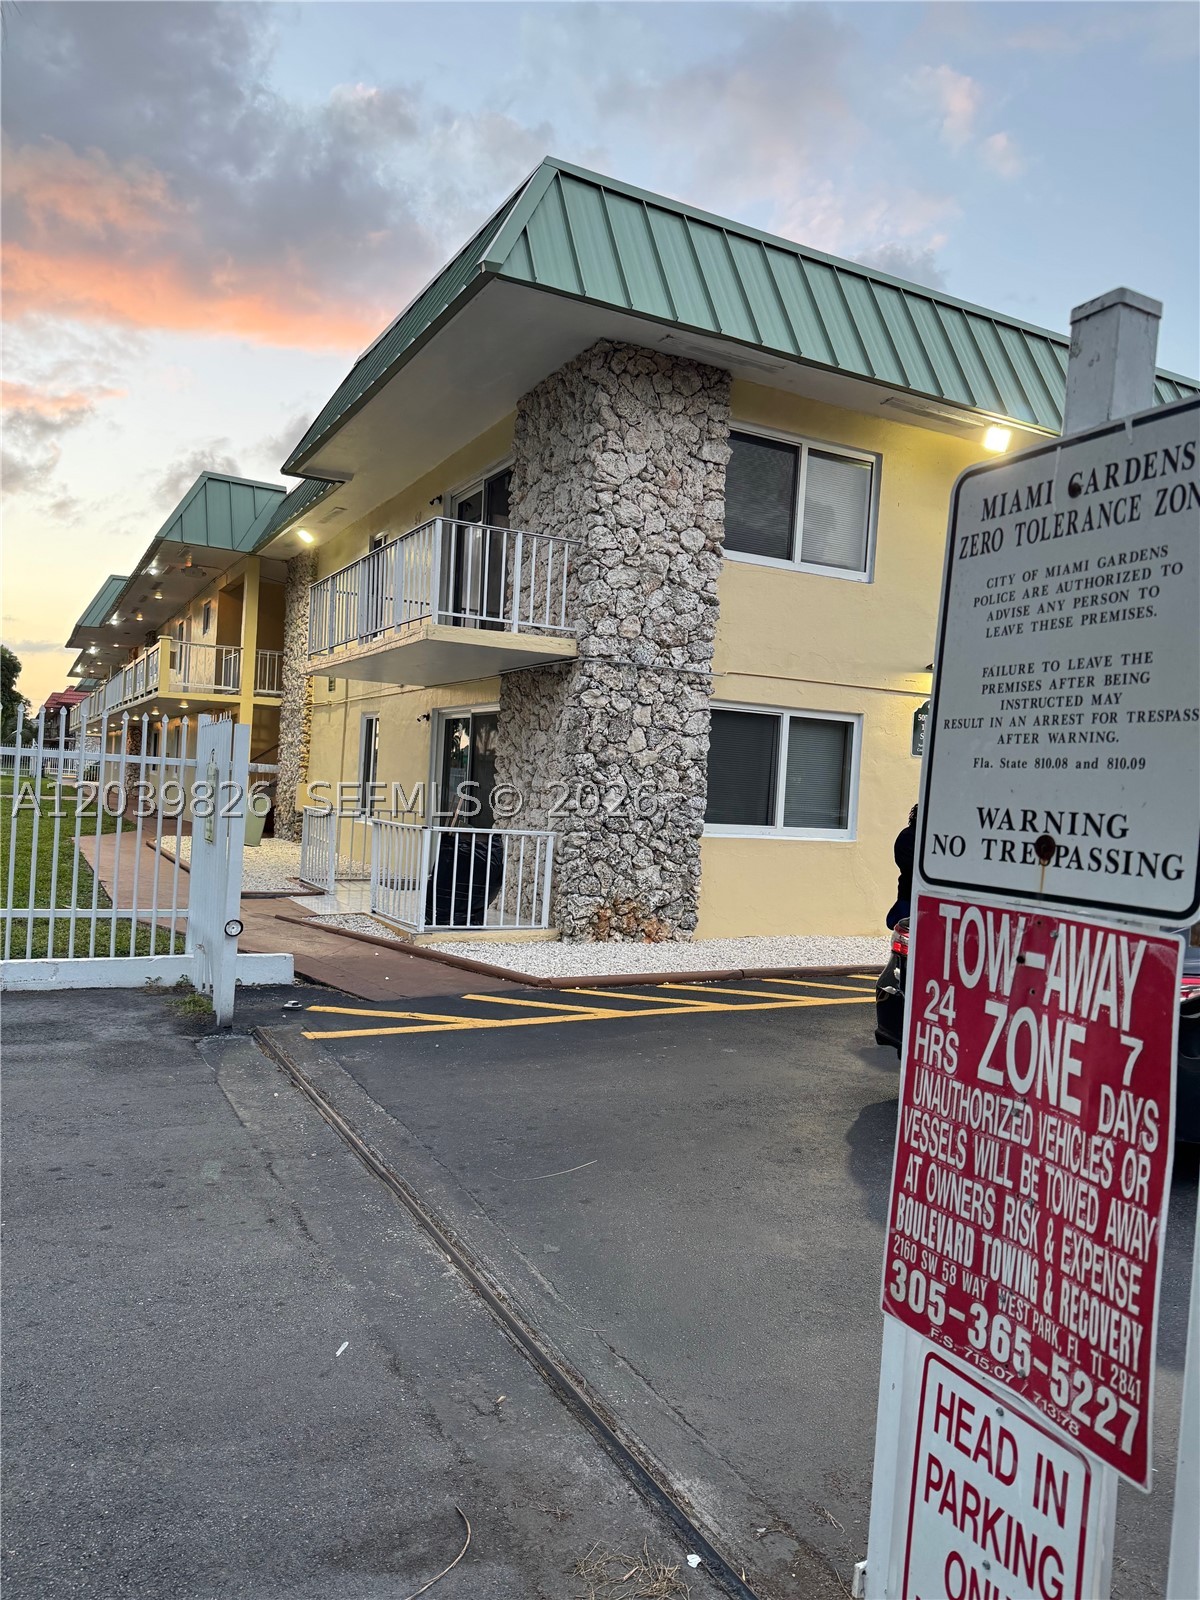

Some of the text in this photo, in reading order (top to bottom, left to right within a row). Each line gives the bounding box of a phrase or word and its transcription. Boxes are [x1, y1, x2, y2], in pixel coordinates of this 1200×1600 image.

[981, 441, 1196, 522] MIAMI GARDENS
[959, 528, 1004, 560] ZERO
[1015, 494, 1142, 548] TOLERANCE
[986, 545, 1169, 589] CITY OF MIAMI GARDENS
[973, 562, 1184, 608] POLICE ARE AUTHORIZED TO
[985, 605, 1158, 639] LEAVE THESE PREMISES.
[986, 585, 1160, 622] ADVISE ANY PERSON TO
[981, 671, 1151, 695] PREMISES AFTER BEING
[982, 651, 1153, 678] FAILURE TO LEAVE THE
[1000, 692, 1122, 711] INSTRUCTED MAY
[943, 708, 1200, 730] RESULT IN AN ARREST FOR TRESPASS
[997, 731, 1119, 745] AFTER WARNING.
[973, 757, 1146, 770] Fla. State 810.08 and 810.09
[931, 833, 967, 858] NO
[976, 806, 1130, 840] WARNING
[939, 903, 1147, 1032] TOW-AWAY
[914, 980, 960, 1075] 24 HRS
[977, 1000, 1086, 1117] ZONE
[1098, 1033, 1159, 1153] 7 DAYS
[913, 1066, 1150, 1206] UNAUTHORIZED VEHICLES OR
[903, 1106, 1157, 1263] VESSELS WILL BE TOWED AWAY
[903, 1153, 1142, 1317] AT OWNERS RISK & EXPENSE
[893, 1235, 1141, 1405] 2160 SW 58 WAY WEST PARK, FL TL 2841
[896, 1192, 1143, 1373] BOULEVARD TOWING & RECOVERY
[890, 1259, 1139, 1456] 305-365-5227
[930, 1327, 957, 1352] F.S.
[963, 1346, 1015, 1383] 715.07
[1033, 1391, 1080, 1436] 713.78
[933, 1382, 1069, 1529] HEAD IN
[924, 1452, 1064, 1600] PARKING
